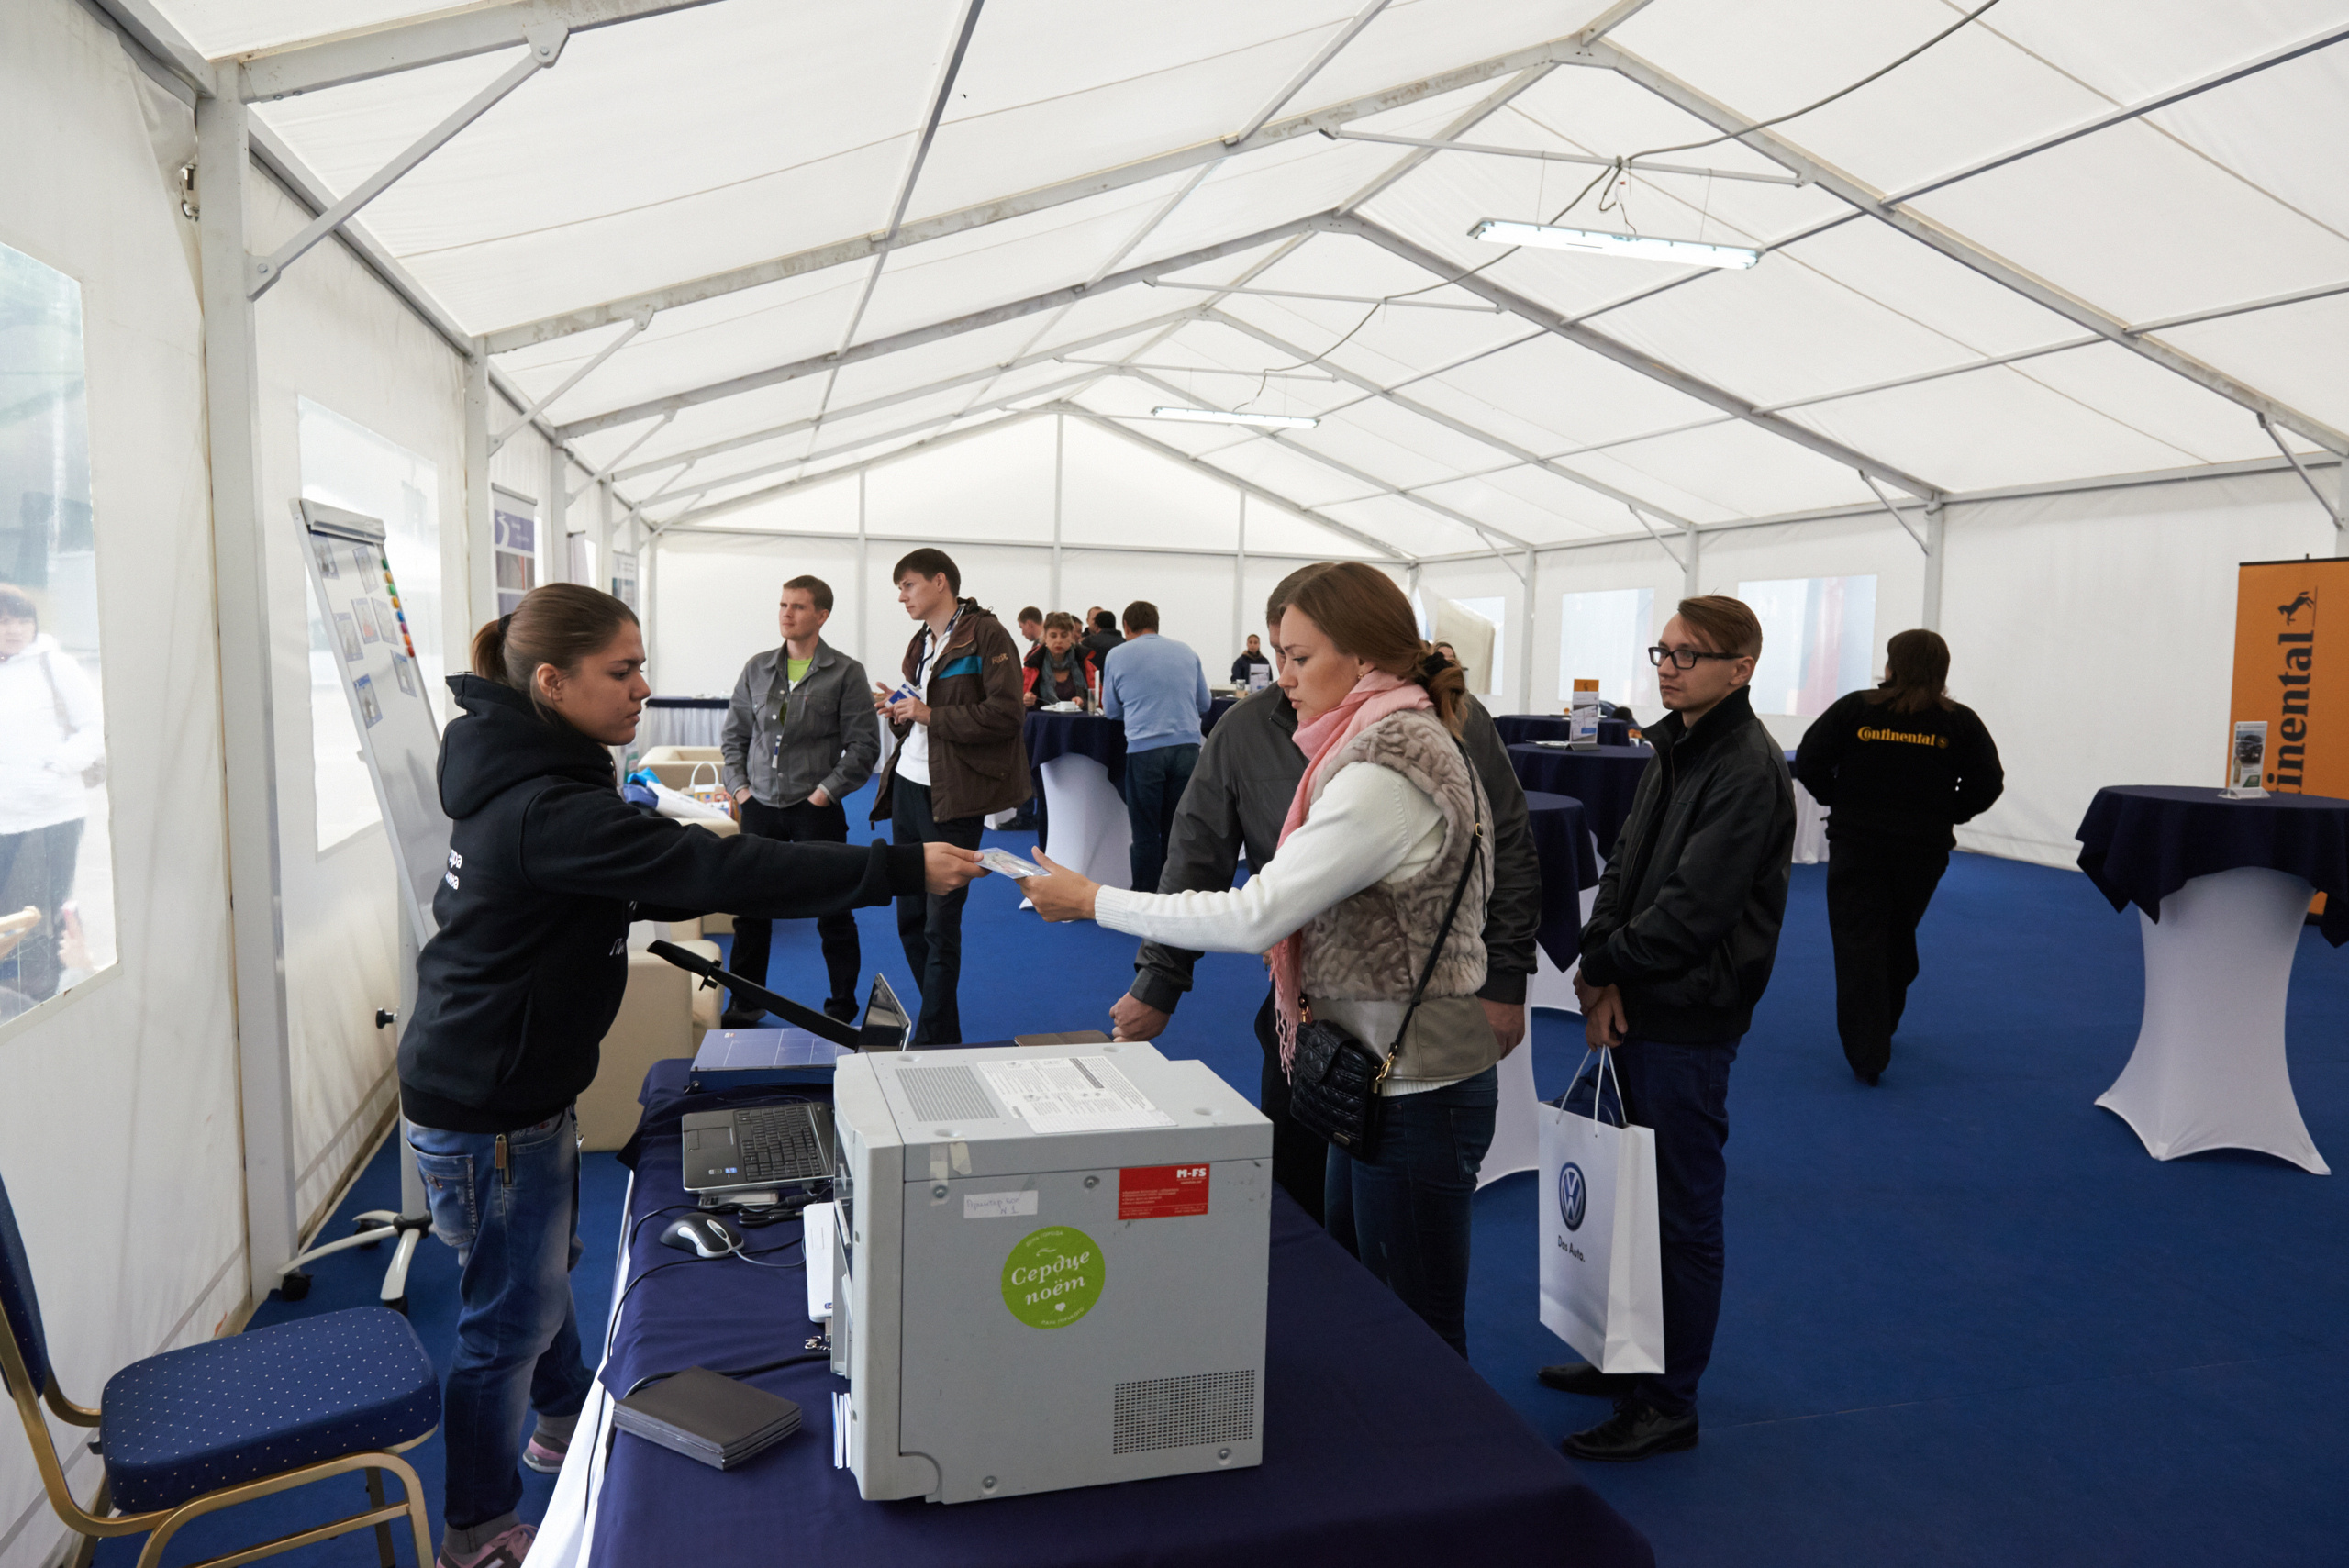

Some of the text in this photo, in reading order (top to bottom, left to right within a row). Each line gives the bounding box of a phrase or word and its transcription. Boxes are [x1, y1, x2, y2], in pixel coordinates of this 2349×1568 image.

[2266, 629, 2315, 795] inental
[1856, 726, 1936, 746] Continental
[1176, 1167, 1207, 1178] M-FS
[1557, 1235, 1568, 1252] Das
[1011, 1251, 1090, 1285] Сердце
[1025, 1276, 1085, 1306] поёт
